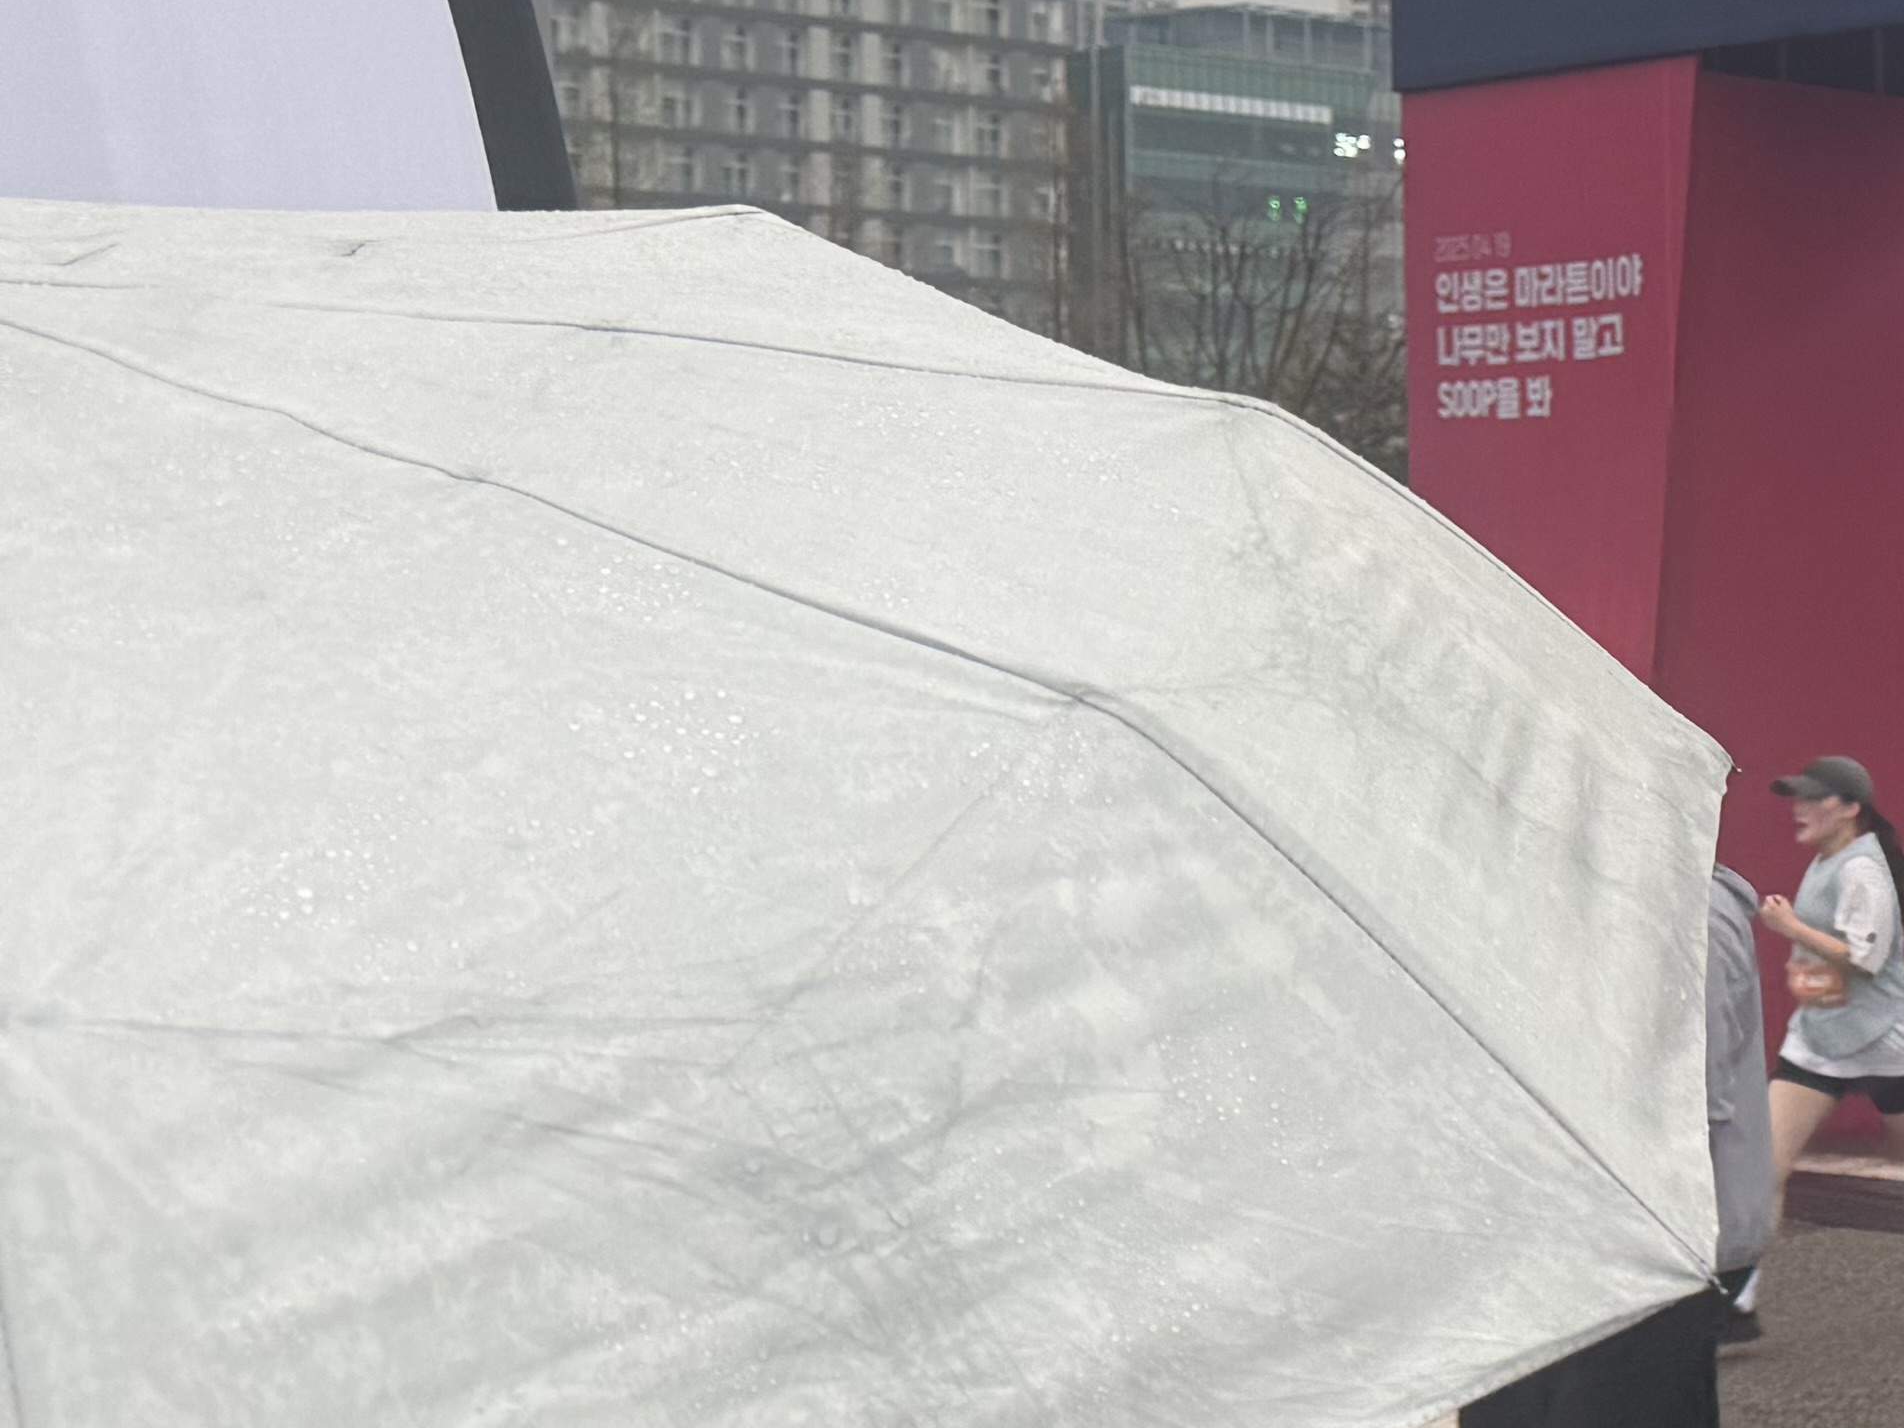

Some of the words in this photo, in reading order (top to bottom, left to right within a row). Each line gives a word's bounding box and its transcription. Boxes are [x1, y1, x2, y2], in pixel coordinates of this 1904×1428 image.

[1435, 268, 1509, 314] 인생은
[1437, 323, 1510, 366] 나무만
[1514, 318, 1566, 363] 보지
[1572, 313, 1625, 361] 말고
